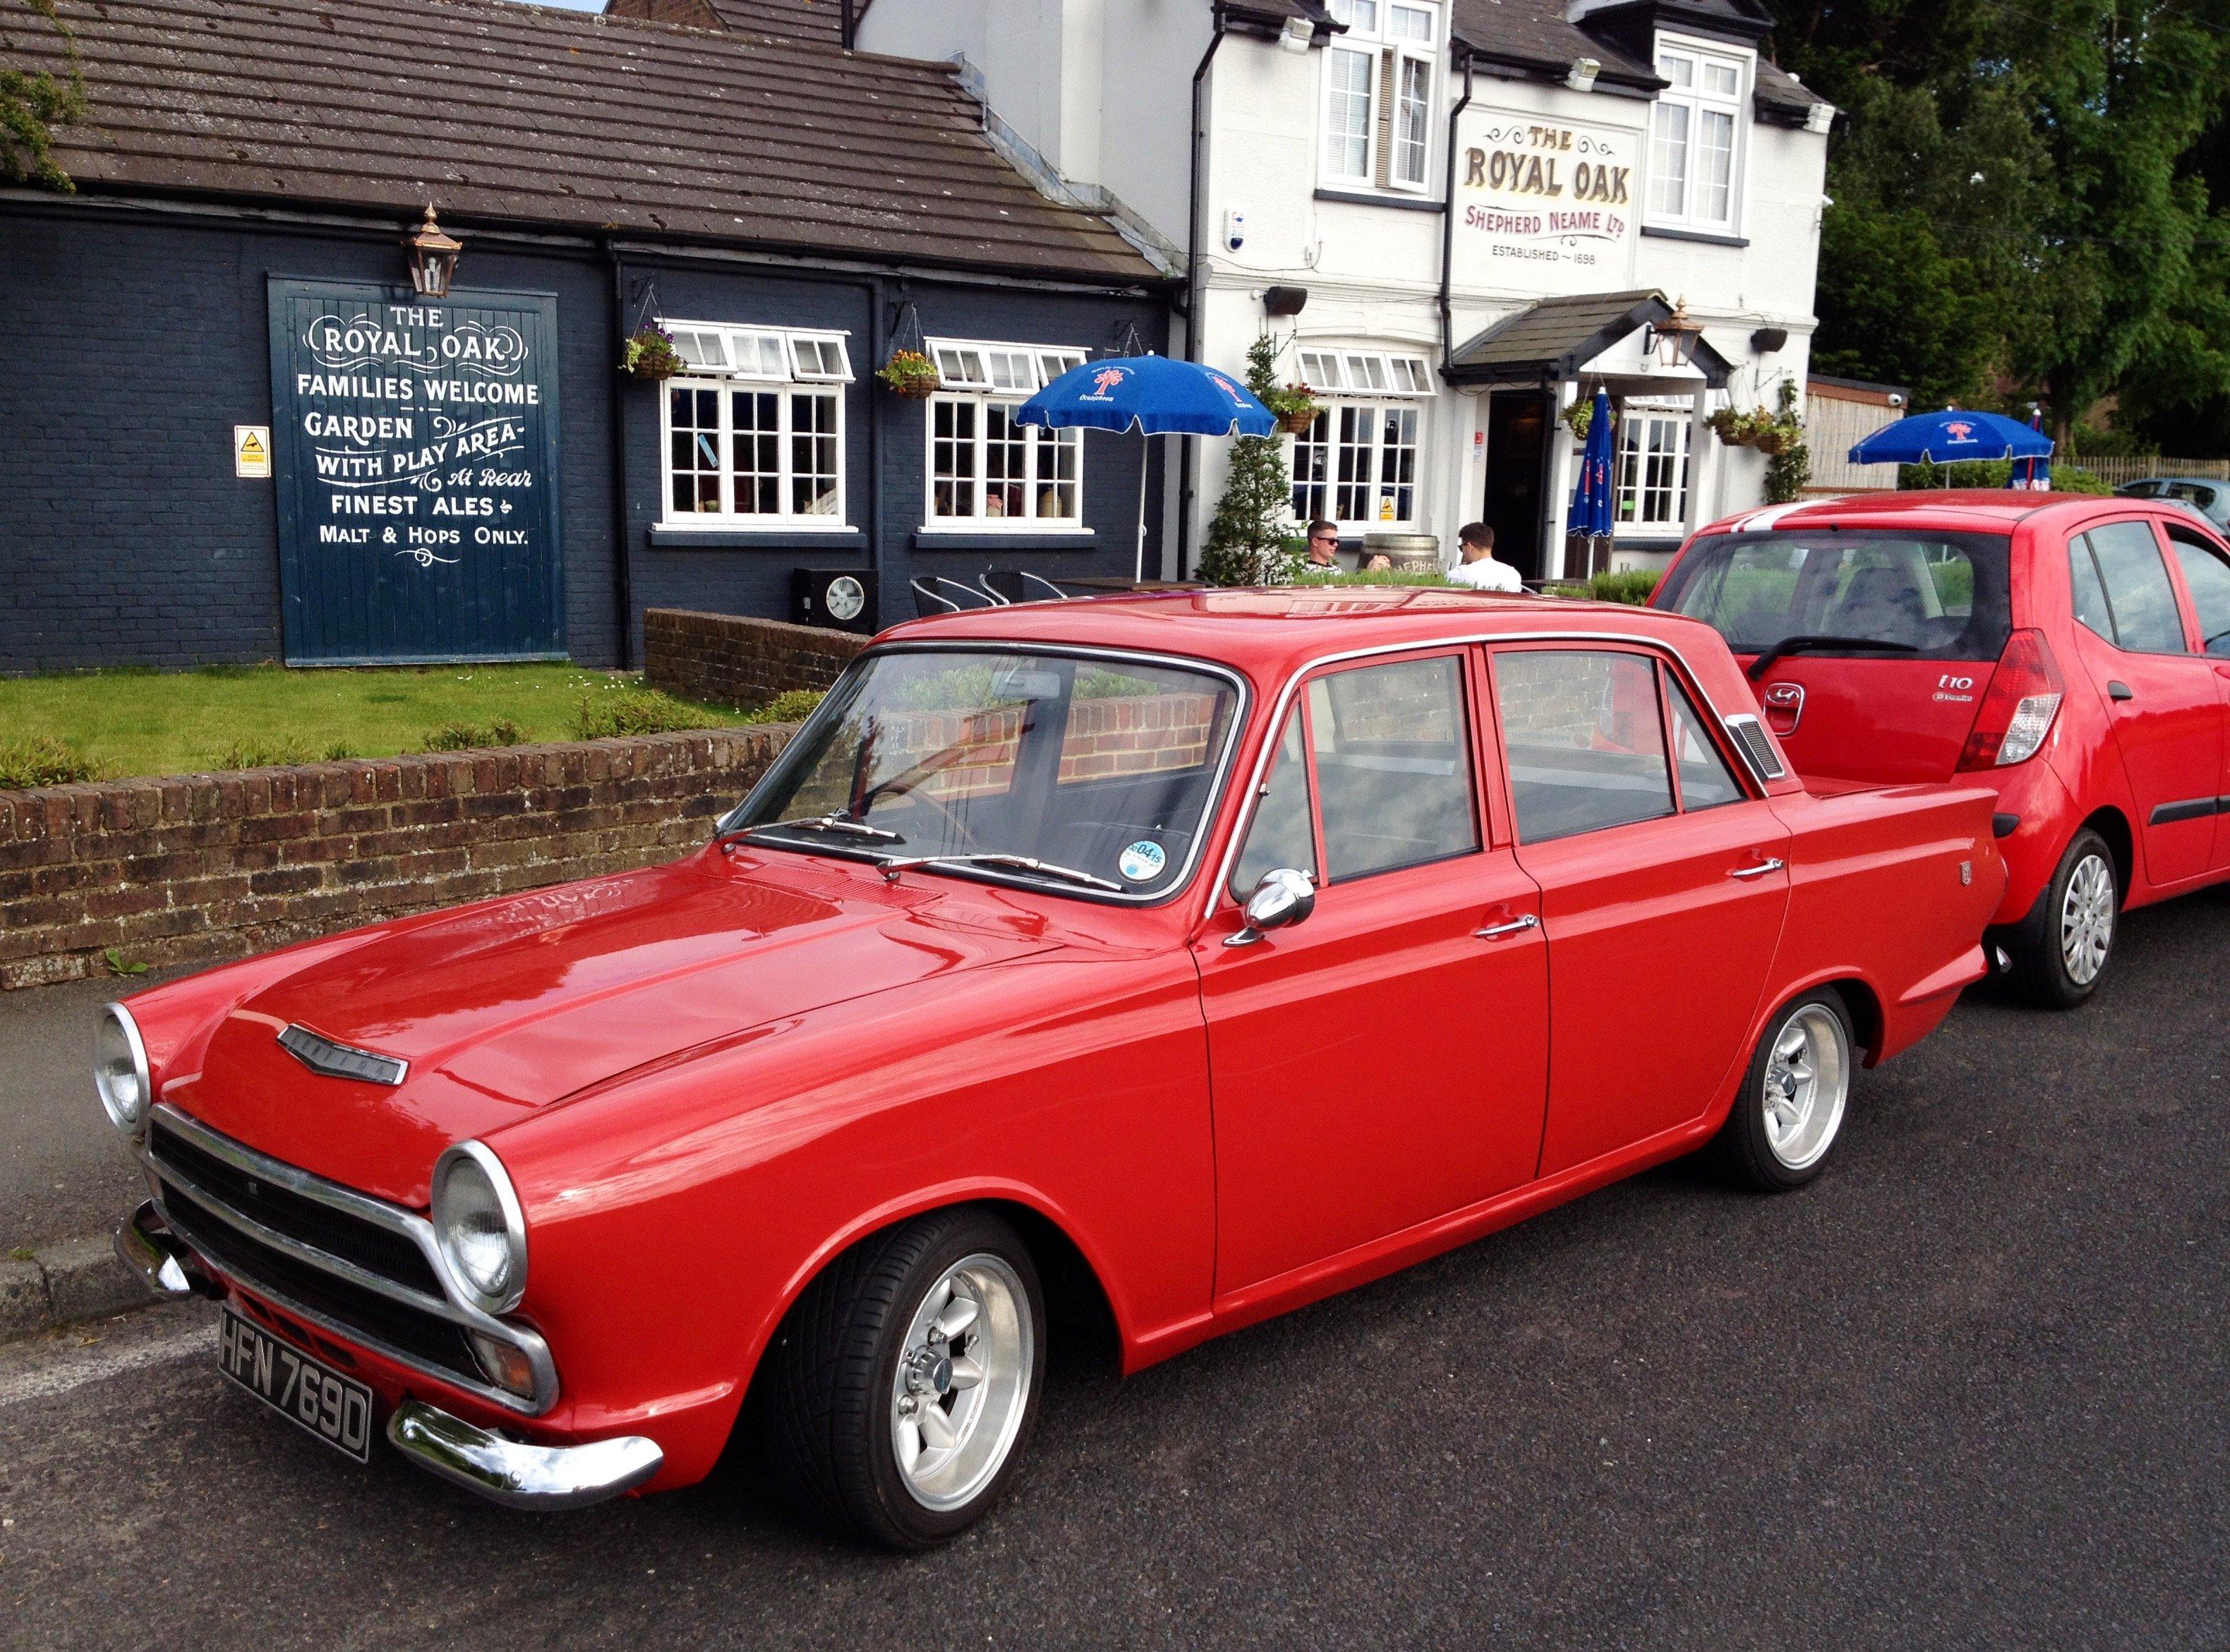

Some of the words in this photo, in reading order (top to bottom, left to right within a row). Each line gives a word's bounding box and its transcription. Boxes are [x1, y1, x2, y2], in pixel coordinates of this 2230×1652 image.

[1527, 126, 1572, 150] THE
[1463, 147, 1564, 197] ROYAL
[1573, 161, 1630, 205] OAK
[1465, 205, 1541, 235] SHEPHERD
[1549, 211, 1601, 231] NEAME
[1492, 245, 1559, 261] ESTABLISHED
[1574, 253, 1596, 265] 1698
[390, 306, 445, 327] THE
[325, 327, 421, 356] ROYAL
[441, 335, 505, 361] OAK
[298, 373, 414, 400] FAMILIES
[425, 380, 539, 405] WELCOME
[304, 412, 413, 446] GARDEN
[315, 453, 382, 478] WITH
[392, 442, 448, 474] PLAY
[447, 467, 474, 487] At
[478, 468, 532, 487] Rear
[331, 494, 418, 515] FINEST
[432, 497, 494, 516] ALES
[320, 526, 370, 543] MALT
[382, 527, 397, 543] &
[409, 526, 461, 544] HOPS
[218, 1312, 274, 1397] HFN
[281, 1350, 366, 1451] 769D
